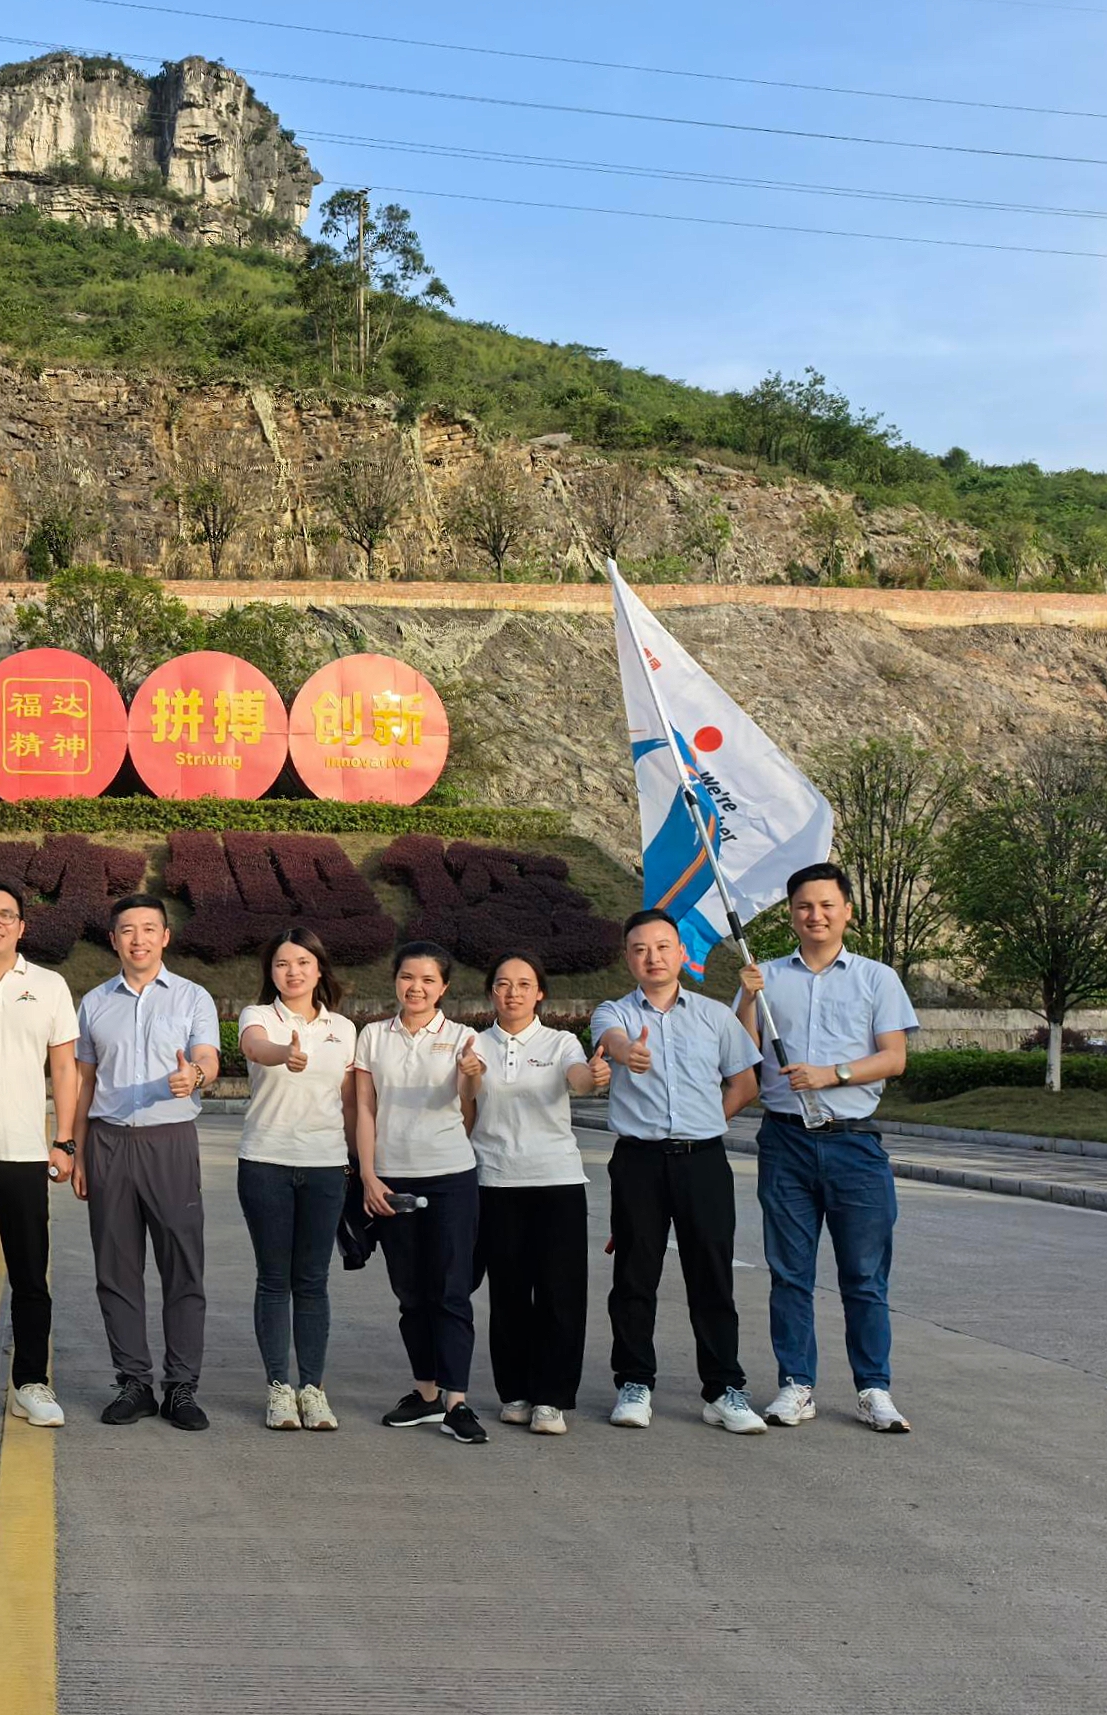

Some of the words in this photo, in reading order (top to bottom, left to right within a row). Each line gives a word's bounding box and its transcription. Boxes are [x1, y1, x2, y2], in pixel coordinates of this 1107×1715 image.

[7, 692, 88, 718] 福达
[151, 688, 266, 744] 拼搏
[311, 690, 426, 746] 创新
[7, 731, 86, 759] 精神
[175, 751, 242, 769] Striving
[324, 756, 412, 769] Innovative
[699, 771, 737, 812] We're
